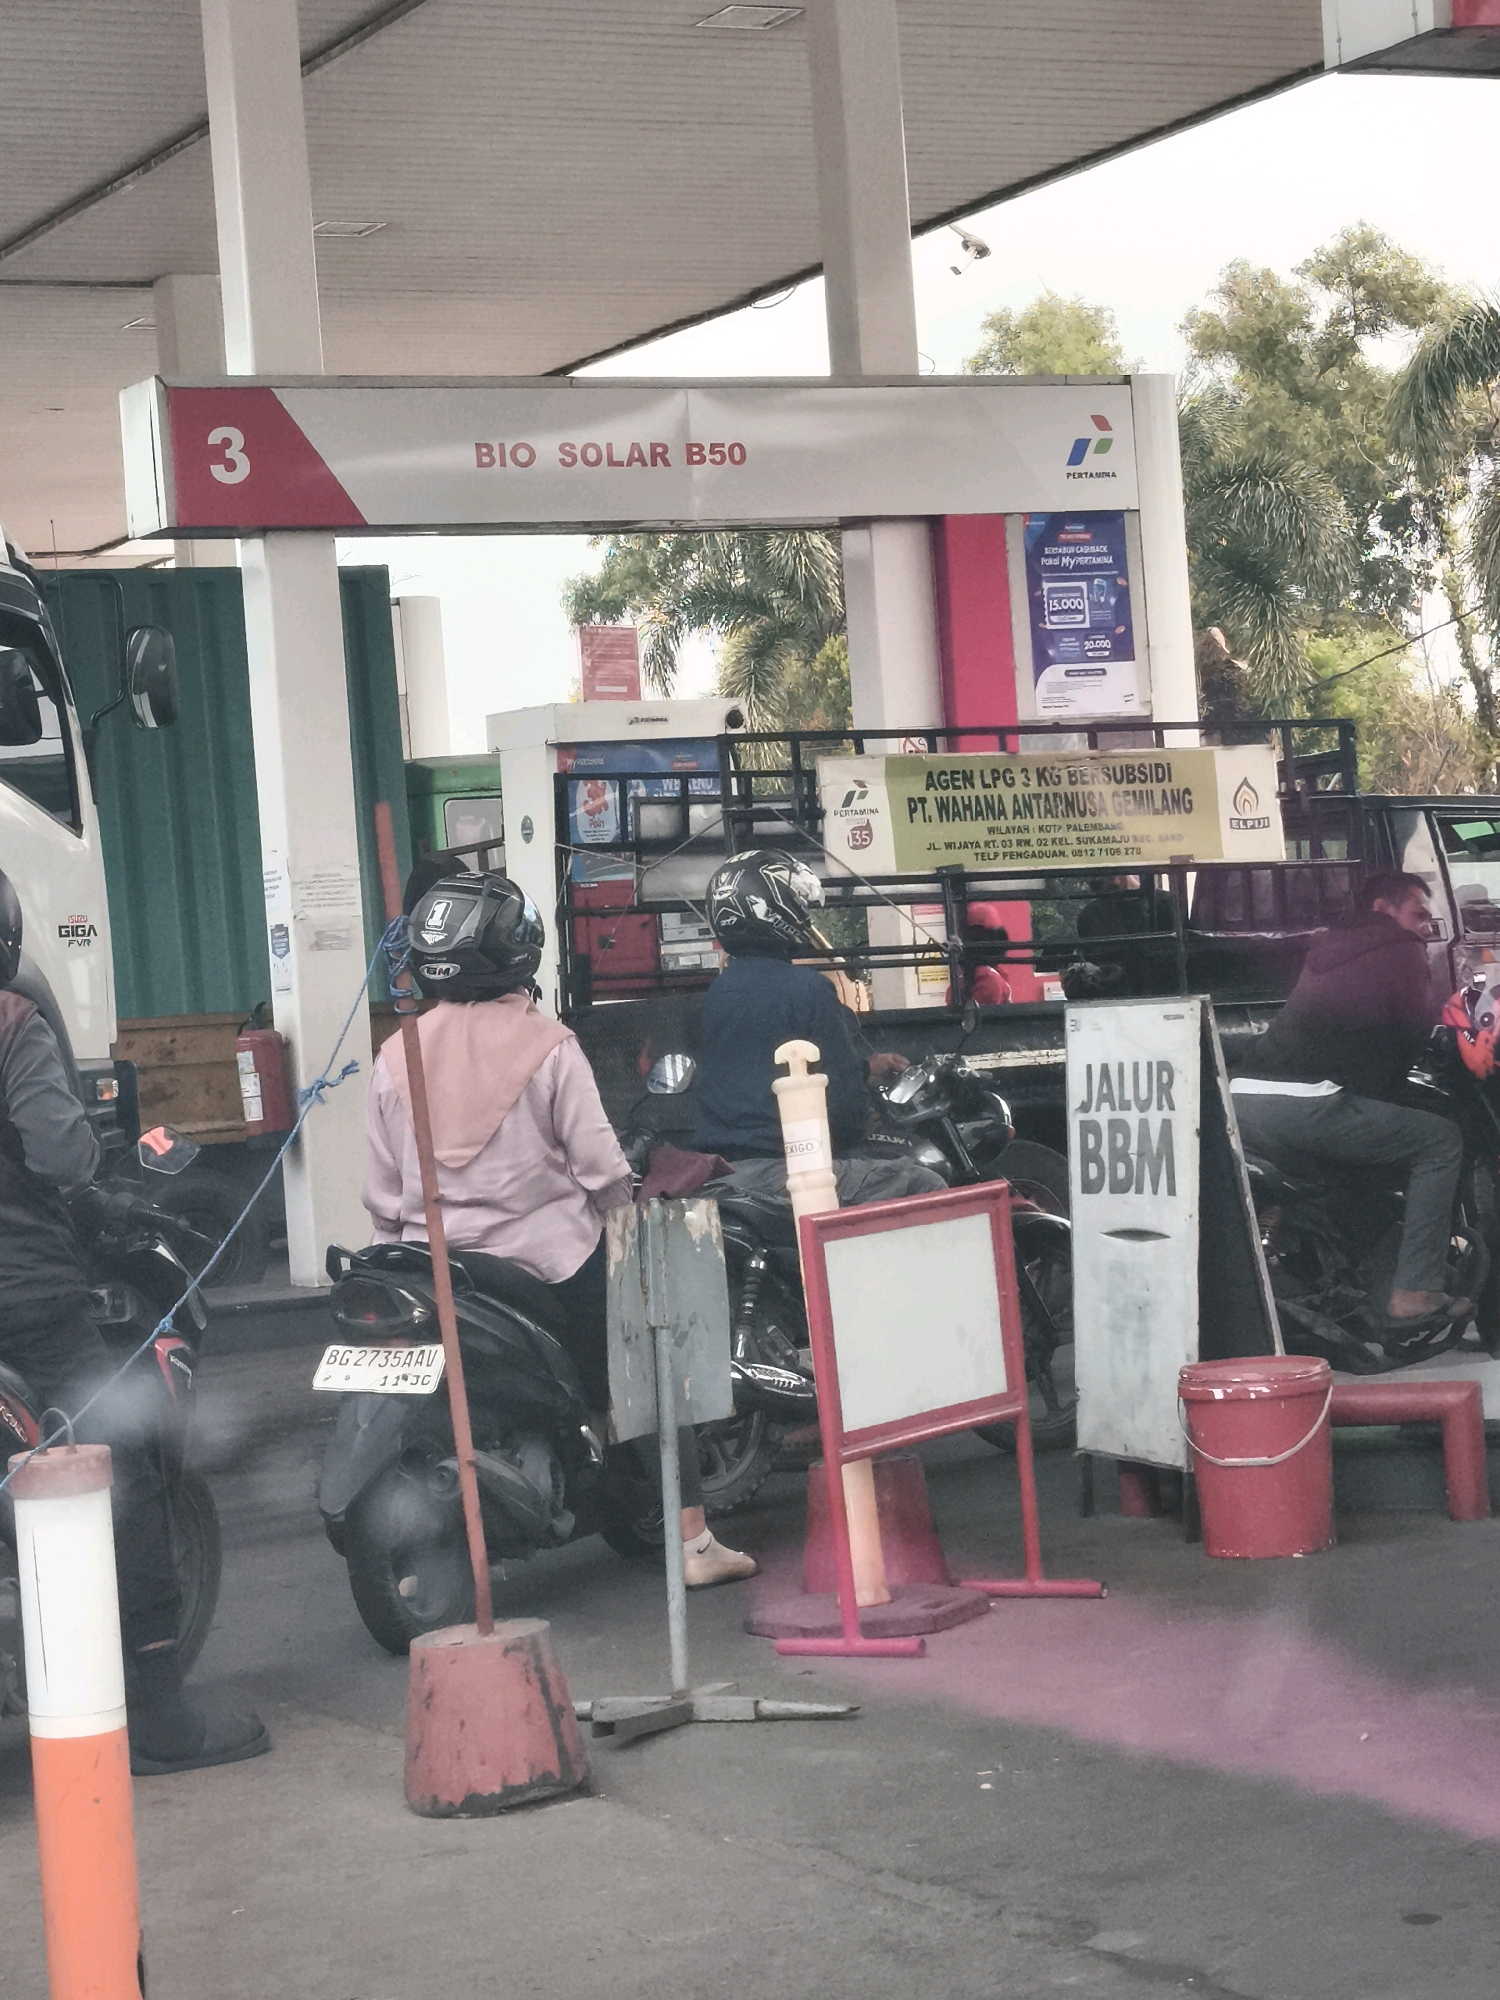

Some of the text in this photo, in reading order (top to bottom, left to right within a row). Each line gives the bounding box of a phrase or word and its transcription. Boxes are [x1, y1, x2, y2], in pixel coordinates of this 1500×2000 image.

[207, 426, 250, 484] 3
[475, 442, 747, 468] BIO SOLAR B50
[1049, 598, 1084, 611] 15.000
[1084, 639, 1111, 650] 20.000
[925, 763, 1172, 791] AGEN LPG 3 KG BERSUBSIDI
[907, 787, 1193, 823] PT. WAHANA ANTARNUSA GEMILANG
[833, 808, 879, 817] PERTAMINA
[1066, 822, 1124, 833] PALEMBANG
[1231, 818, 1269, 829] ELPIJI
[849, 830, 870, 847] 135
[944, 840, 981, 851] WIJAYA
[1001, 839, 1013, 848] 03
[1036, 837, 1049, 847] 02
[1076, 834, 1130, 845] SUKAMAJU
[974, 851, 1000, 861] TELP
[68, 914, 88, 923] ISUZU
[58, 925, 98, 938] GIGA
[68, 939, 91, 948] FVR
[1075, 1060, 1176, 1114] JALUR
[1079, 1118, 1177, 1196] BBM
